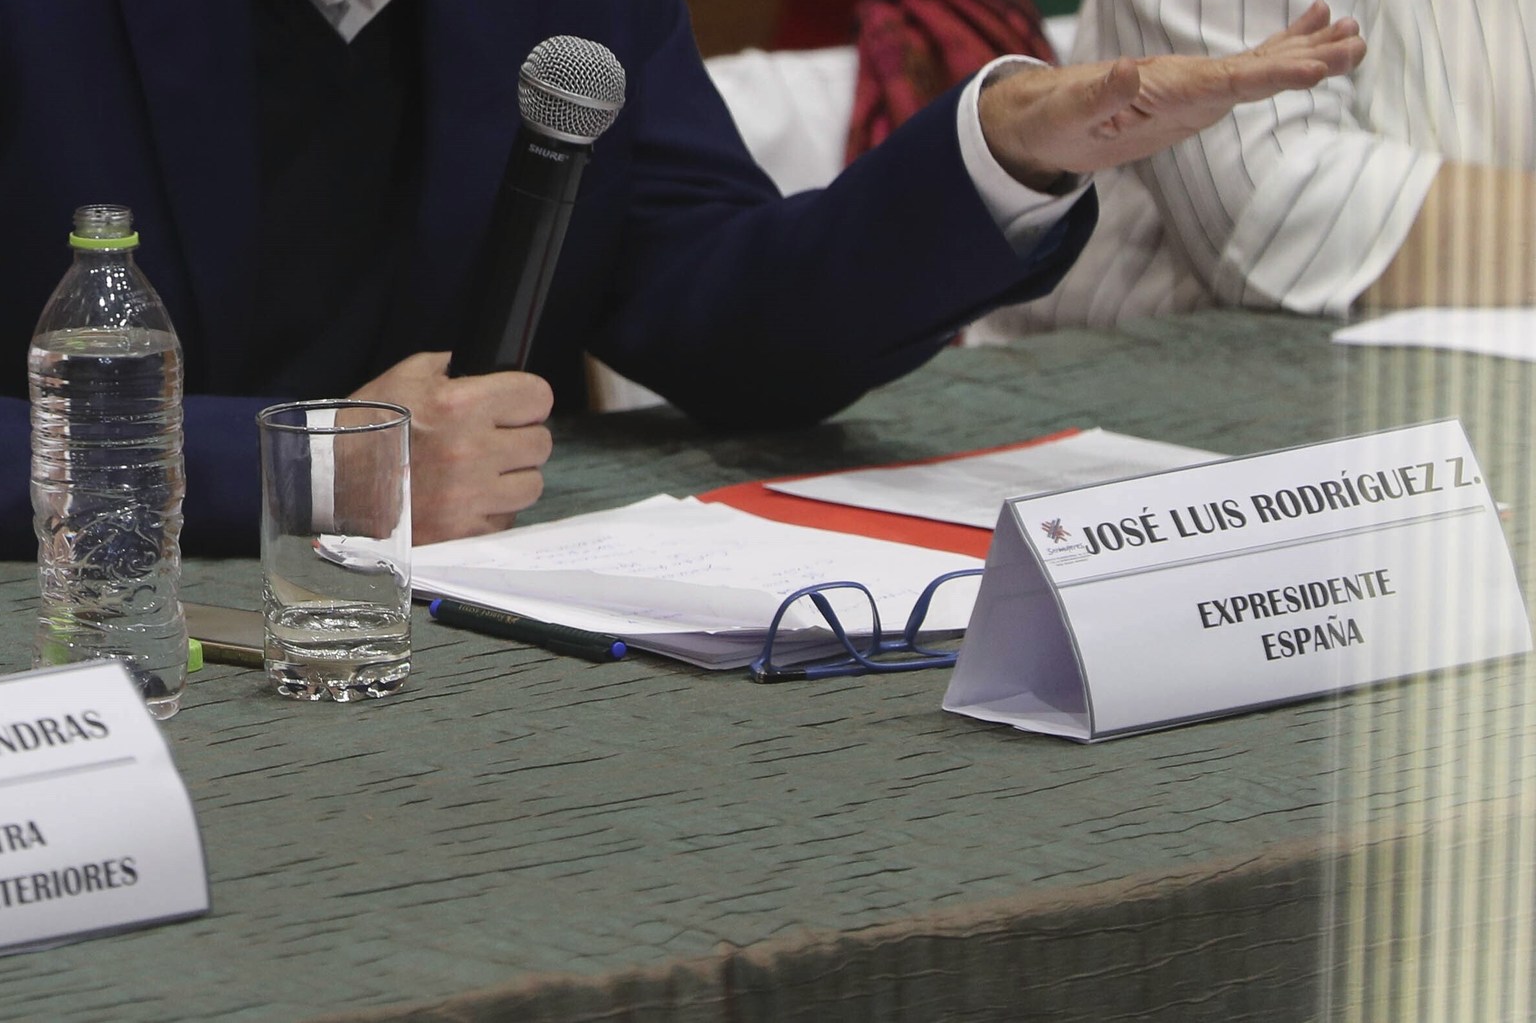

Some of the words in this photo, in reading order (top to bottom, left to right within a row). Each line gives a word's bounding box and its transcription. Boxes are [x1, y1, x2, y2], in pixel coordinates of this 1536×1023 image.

[529, 143, 565, 162] SHURE
[1082, 506, 1168, 556] JOSÉ
[1170, 499, 1246, 538] LUIS
[1249, 463, 1443, 524] RODRÍGUEZ
[1446, 456, 1481, 488] Z.
[1196, 569, 1395, 629] EXPRESIDENTE
[1261, 614, 1364, 661] ESPAÑA
